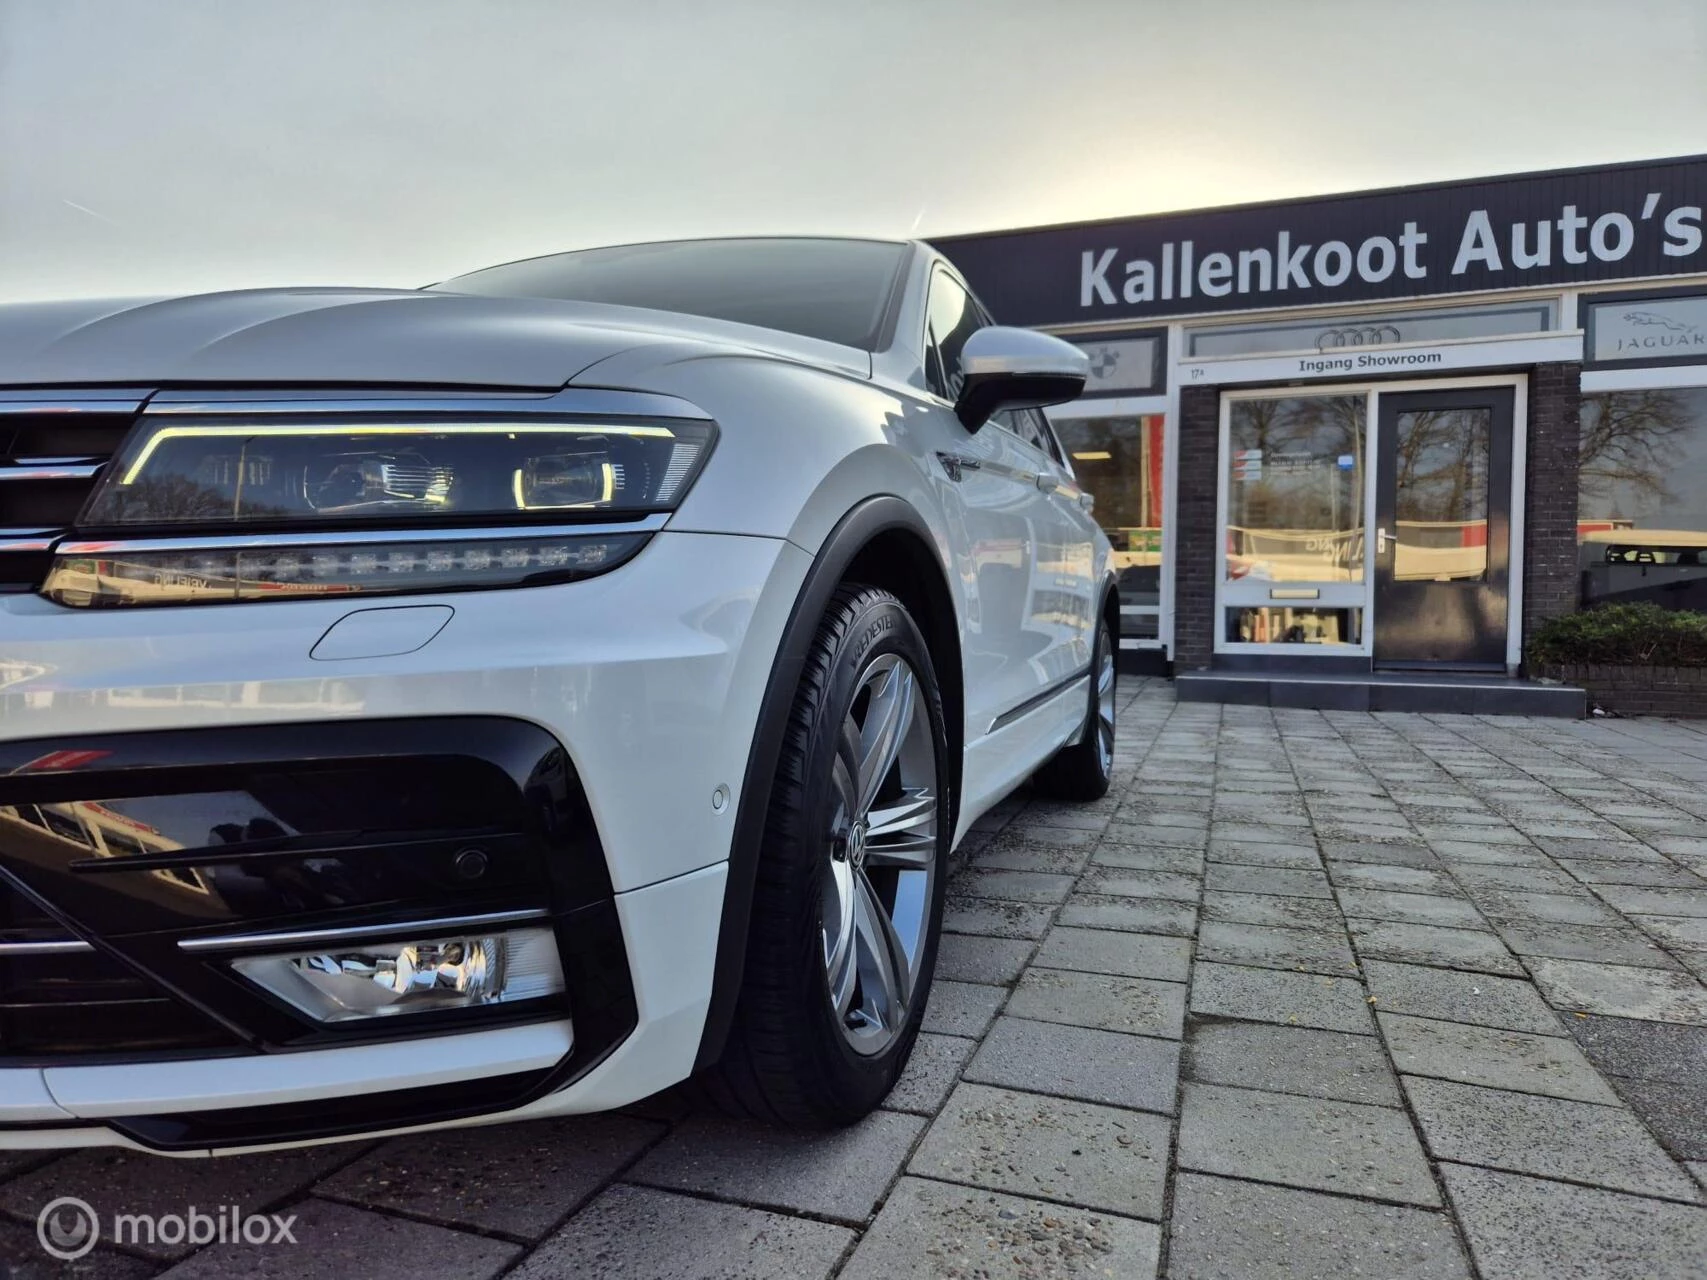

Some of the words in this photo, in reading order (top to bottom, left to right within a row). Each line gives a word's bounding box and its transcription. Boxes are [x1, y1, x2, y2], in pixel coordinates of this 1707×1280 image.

[1080, 222, 1427, 307] Kallenkoot
[1451, 193, 1703, 275] Auto's
[1617, 333, 1705, 351] JAGUAR
[1299, 358, 1353, 373] Ingang
[1357, 352, 1442, 368] Showroom
